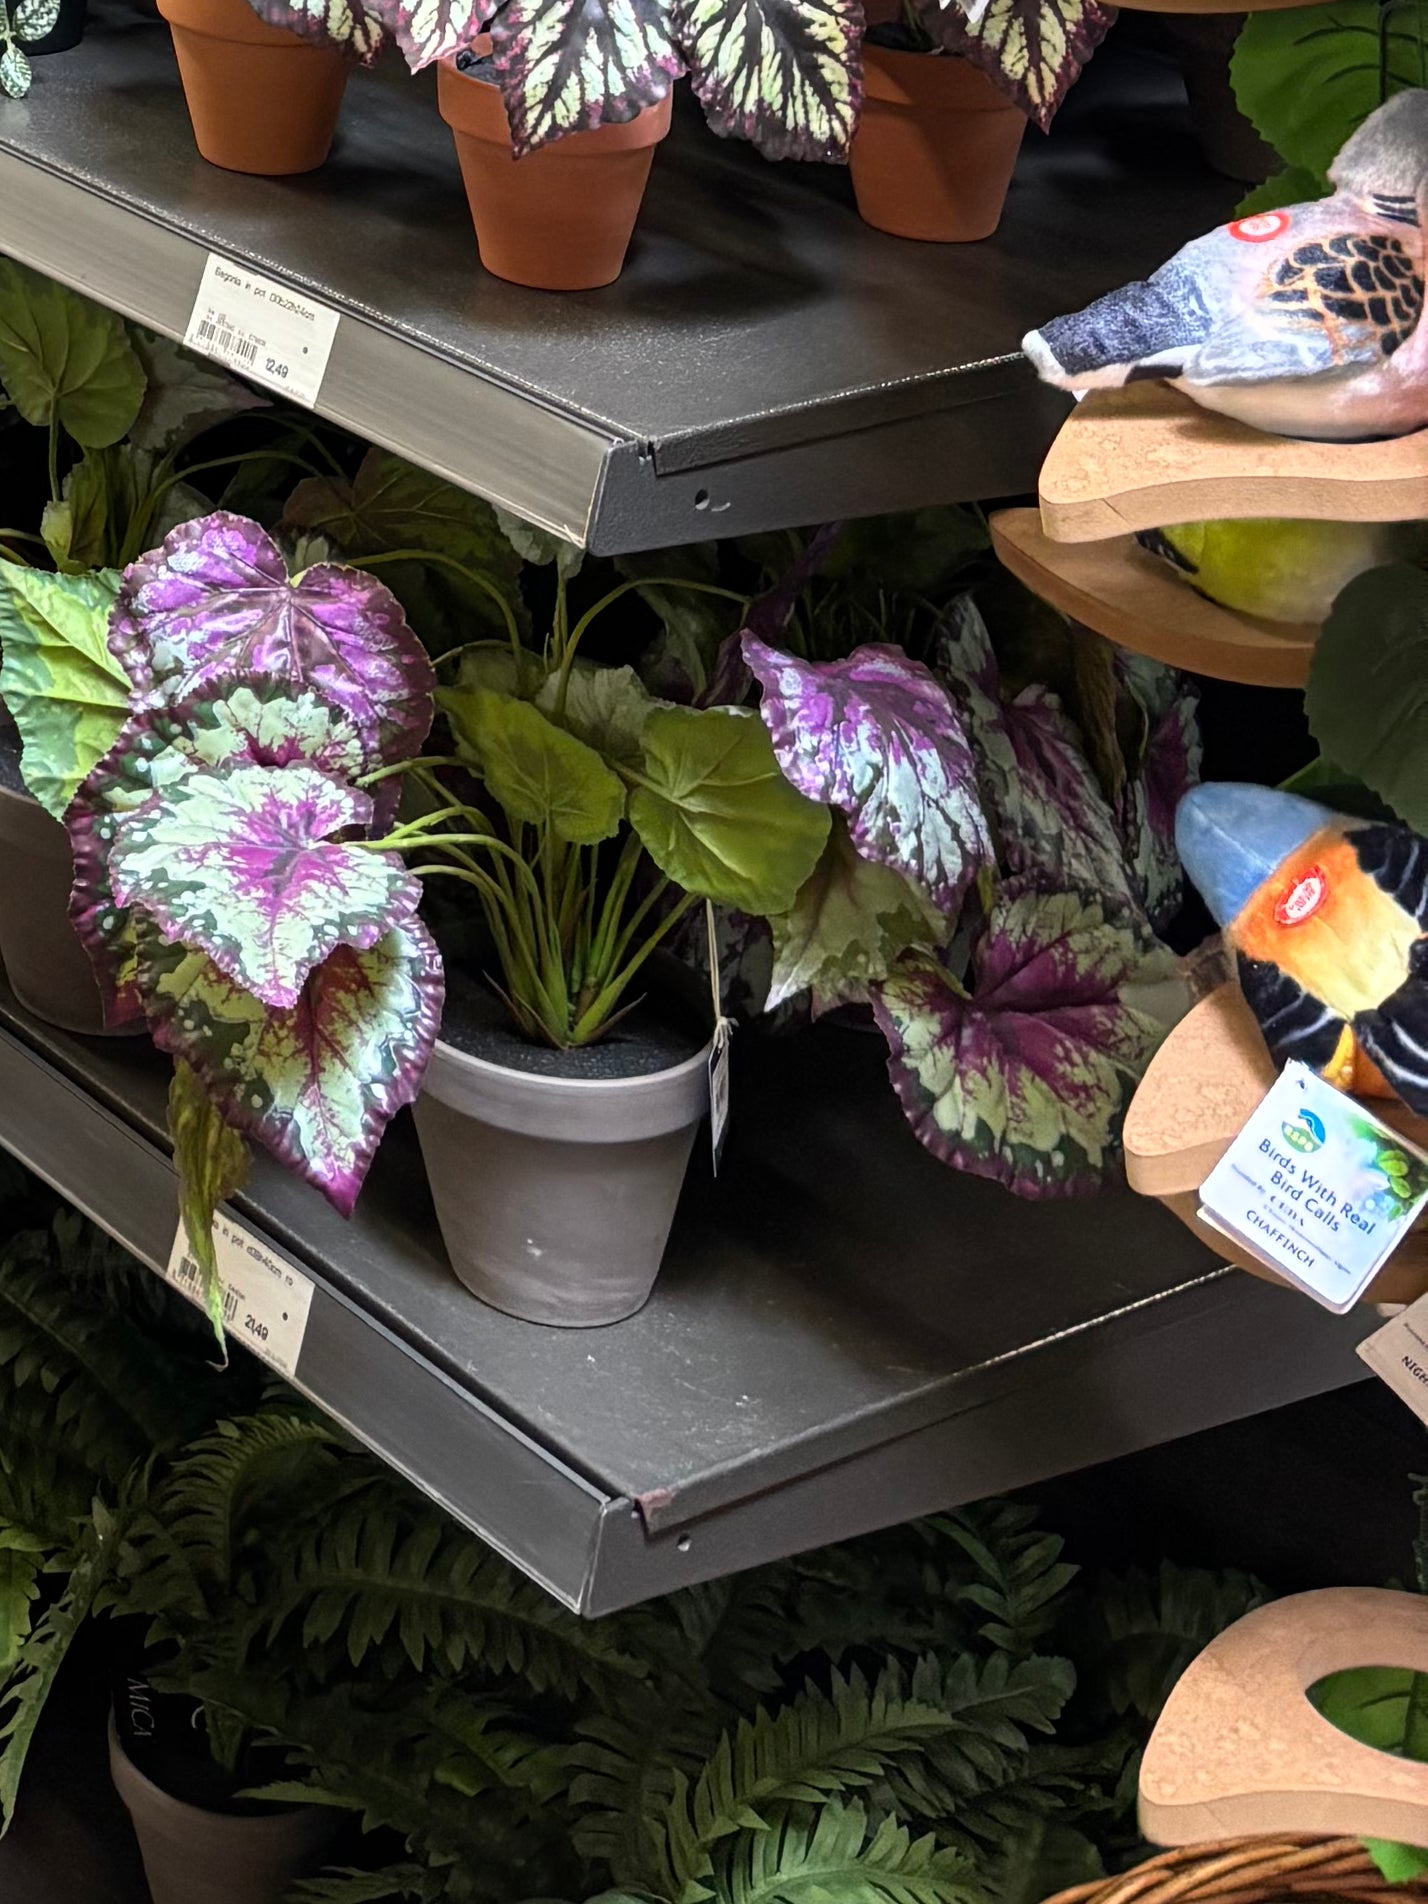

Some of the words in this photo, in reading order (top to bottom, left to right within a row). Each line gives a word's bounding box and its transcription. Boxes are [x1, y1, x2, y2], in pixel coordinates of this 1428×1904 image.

[265, 357, 290, 379] 12,49
[1259, 1138, 1296, 1175] Birds
[1301, 1169, 1337, 1207] With
[1340, 1202, 1377, 1236] Real
[1270, 1170, 1304, 1201] Bird
[1305, 1198, 1341, 1233] Calls
[1246, 1209, 1316, 1269] CHAFFINCH
